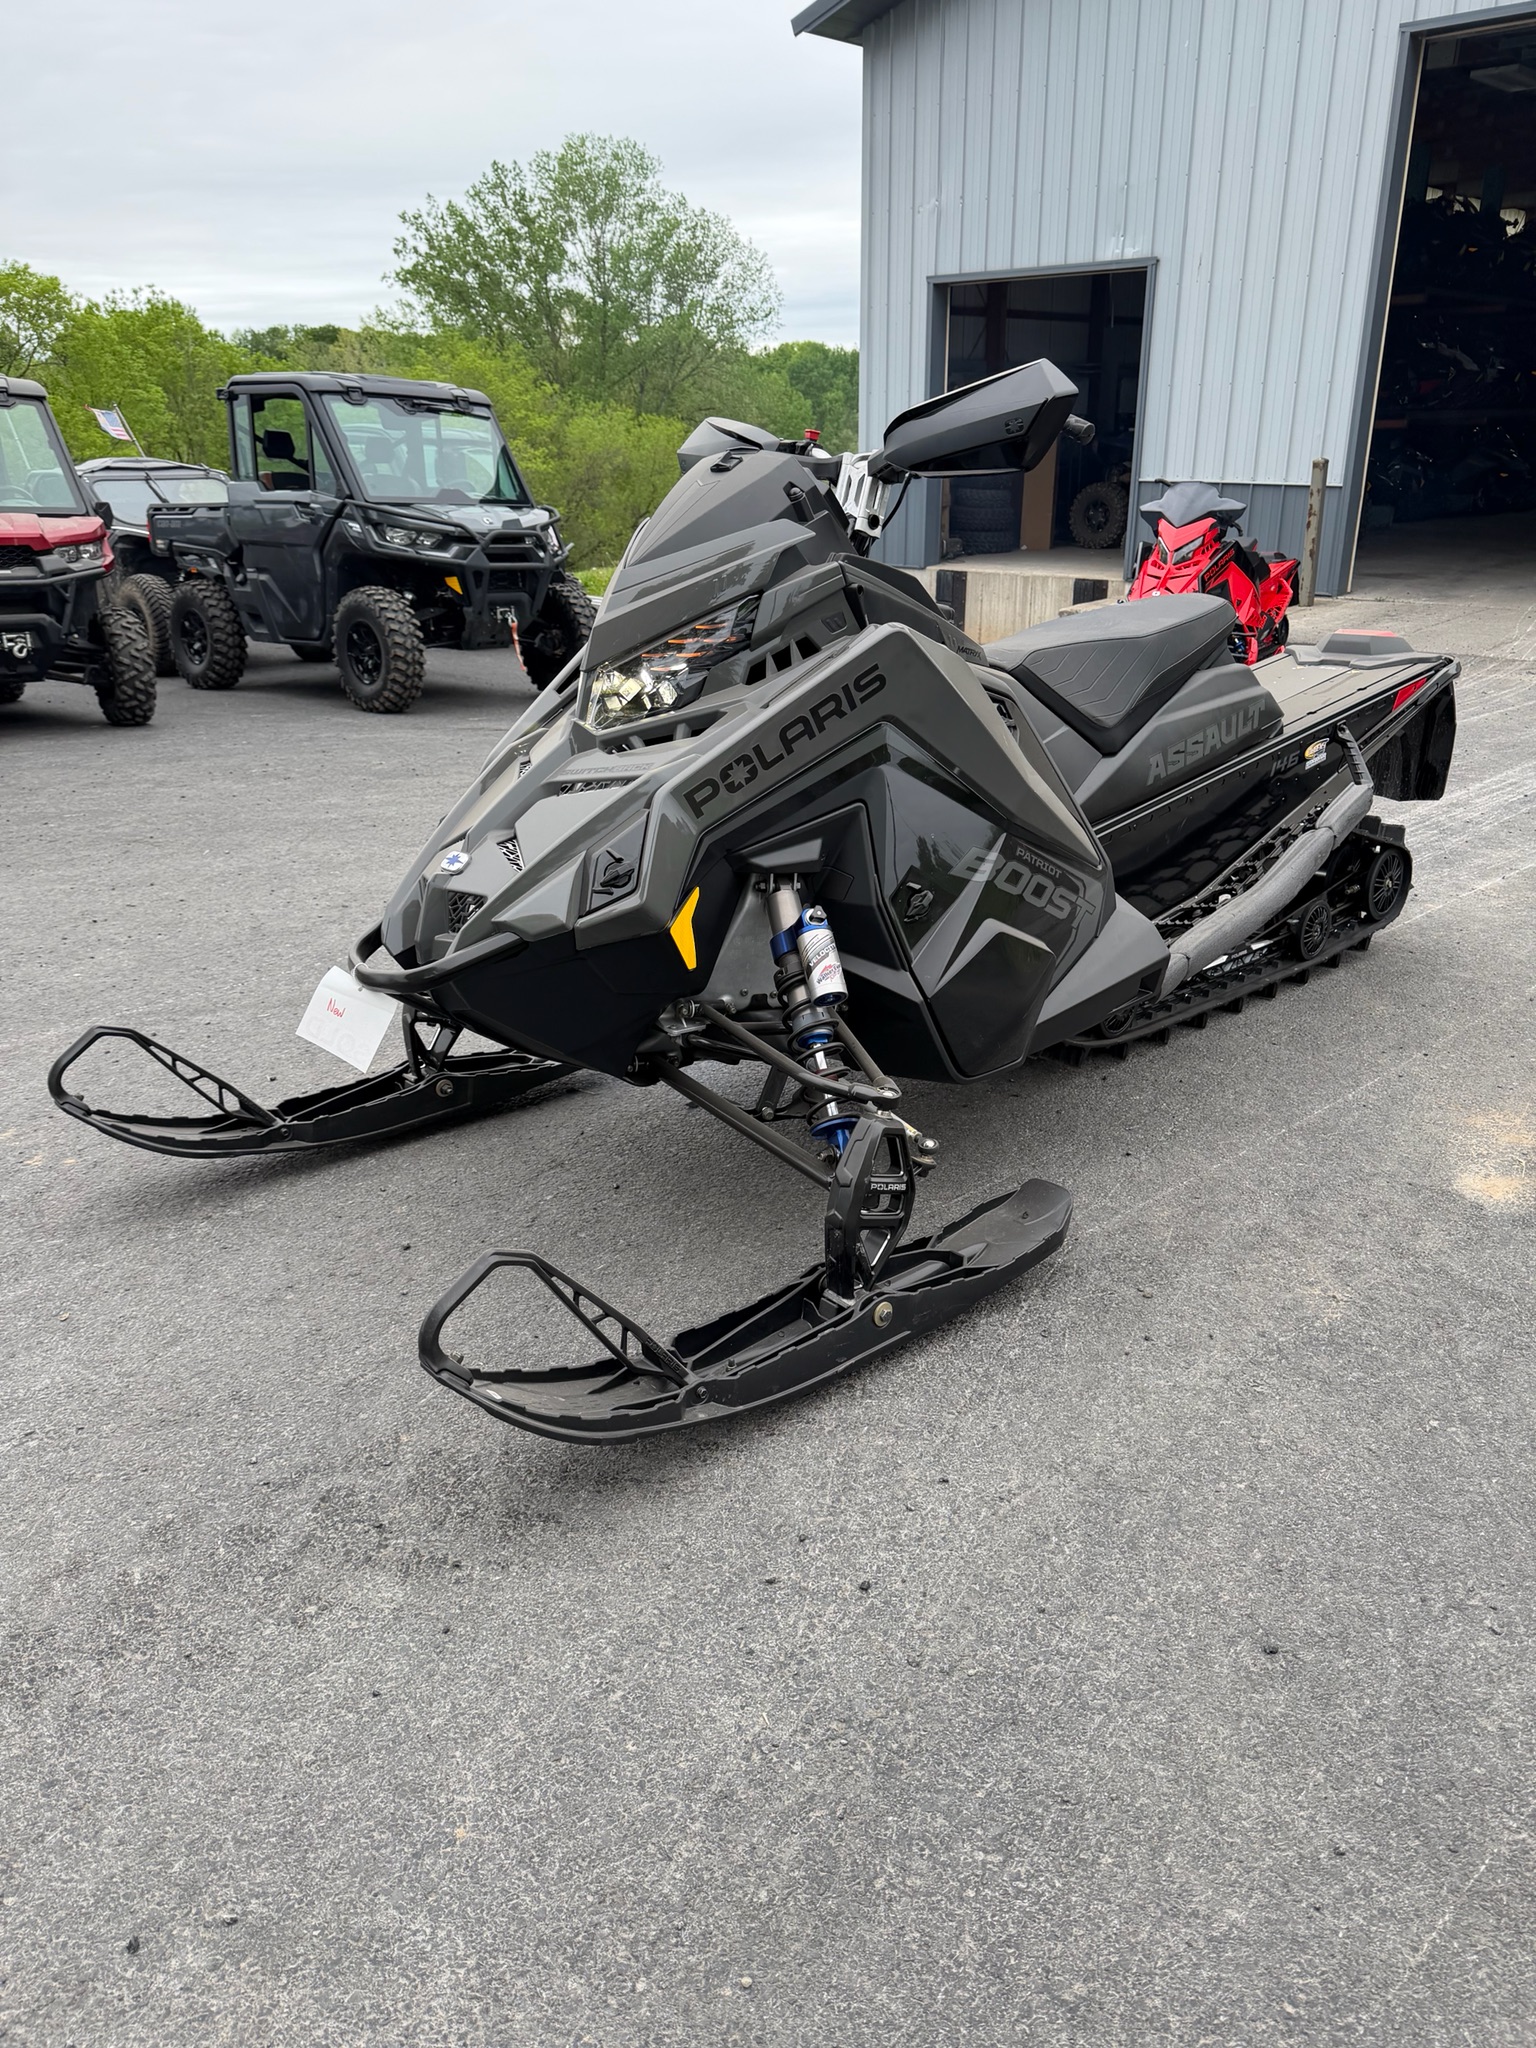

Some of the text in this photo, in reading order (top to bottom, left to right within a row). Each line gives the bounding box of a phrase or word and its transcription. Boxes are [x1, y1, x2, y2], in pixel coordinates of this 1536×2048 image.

[1203, 549, 1235, 581] POLARIS
[683, 663, 887, 820] POLARIS
[1146, 698, 1266, 786] ASSAULT
[1270, 750, 1301, 777] 146
[1015, 847, 1063, 879] PATRIOT
[947, 845, 1097, 929] BOOST
[808, 944, 836, 967] VELOCIT
[326, 997, 346, 1018] New
[870, 1183, 907, 1191] POLARIS
